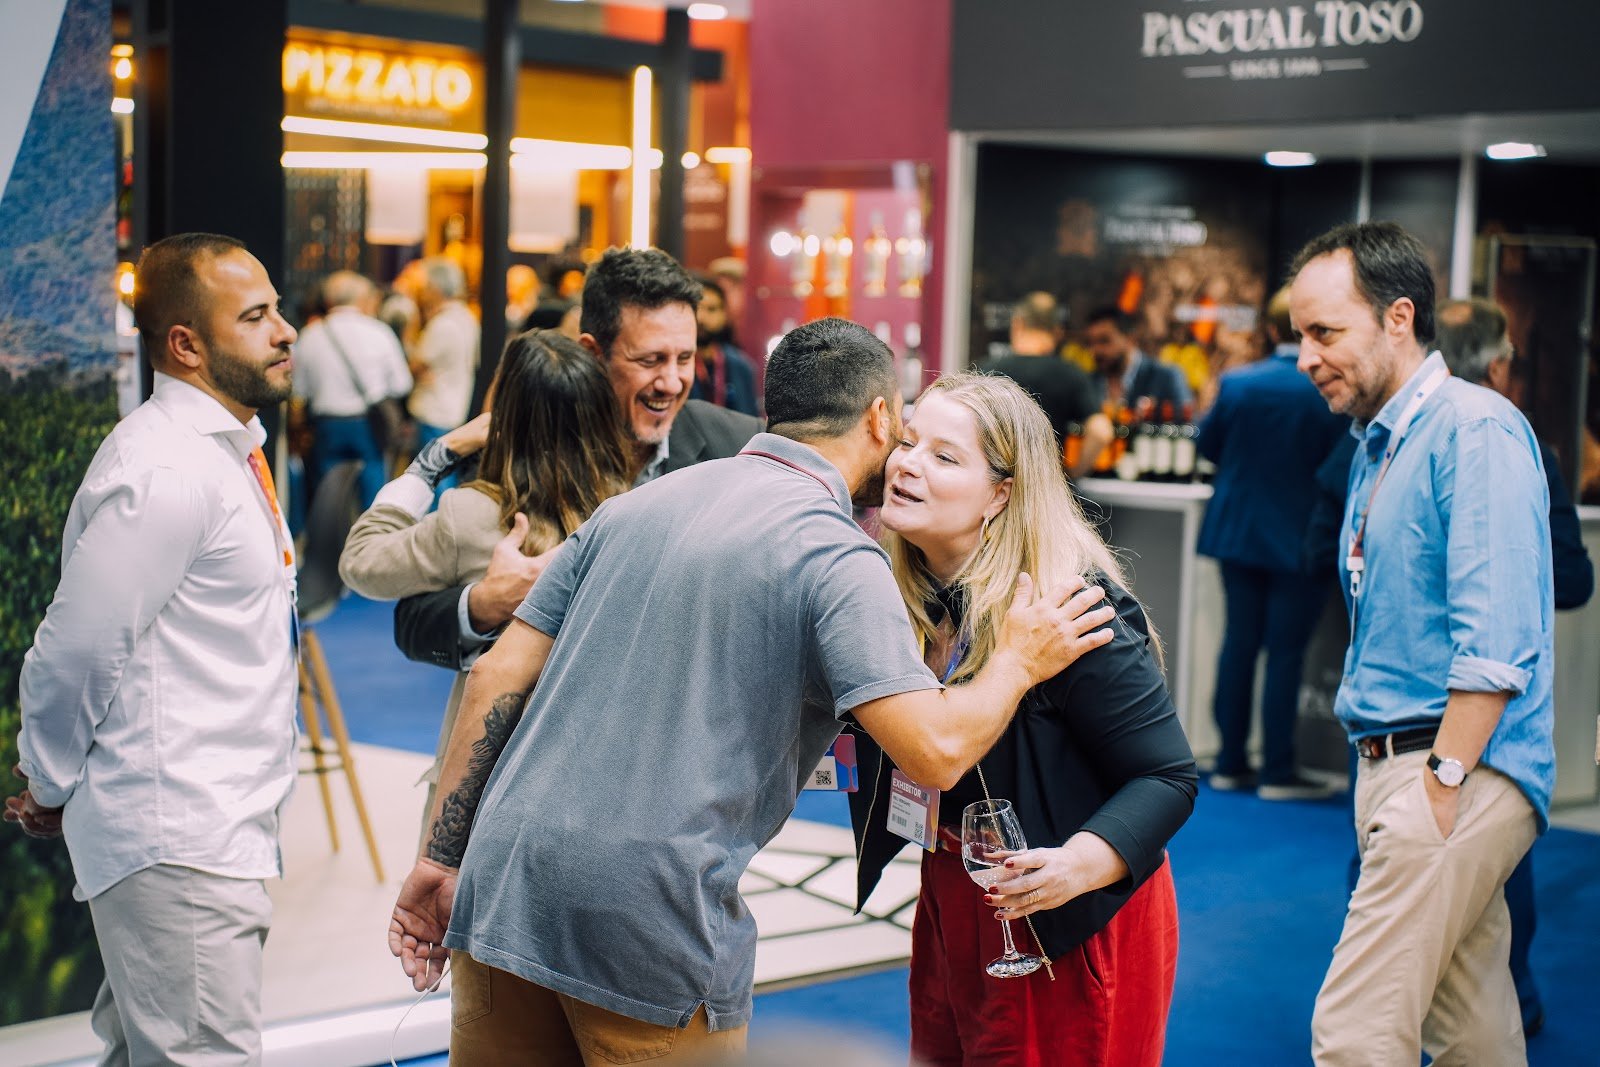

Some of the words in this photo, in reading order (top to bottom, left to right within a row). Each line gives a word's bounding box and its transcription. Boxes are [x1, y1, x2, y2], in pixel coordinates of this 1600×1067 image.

[1142, 6, 1316, 56] PASCUAL
[1316, 0, 1423, 46] TOSO
[283, 45, 472, 110] PIZZATO
[892, 778, 922, 798] EXHIBITOR
